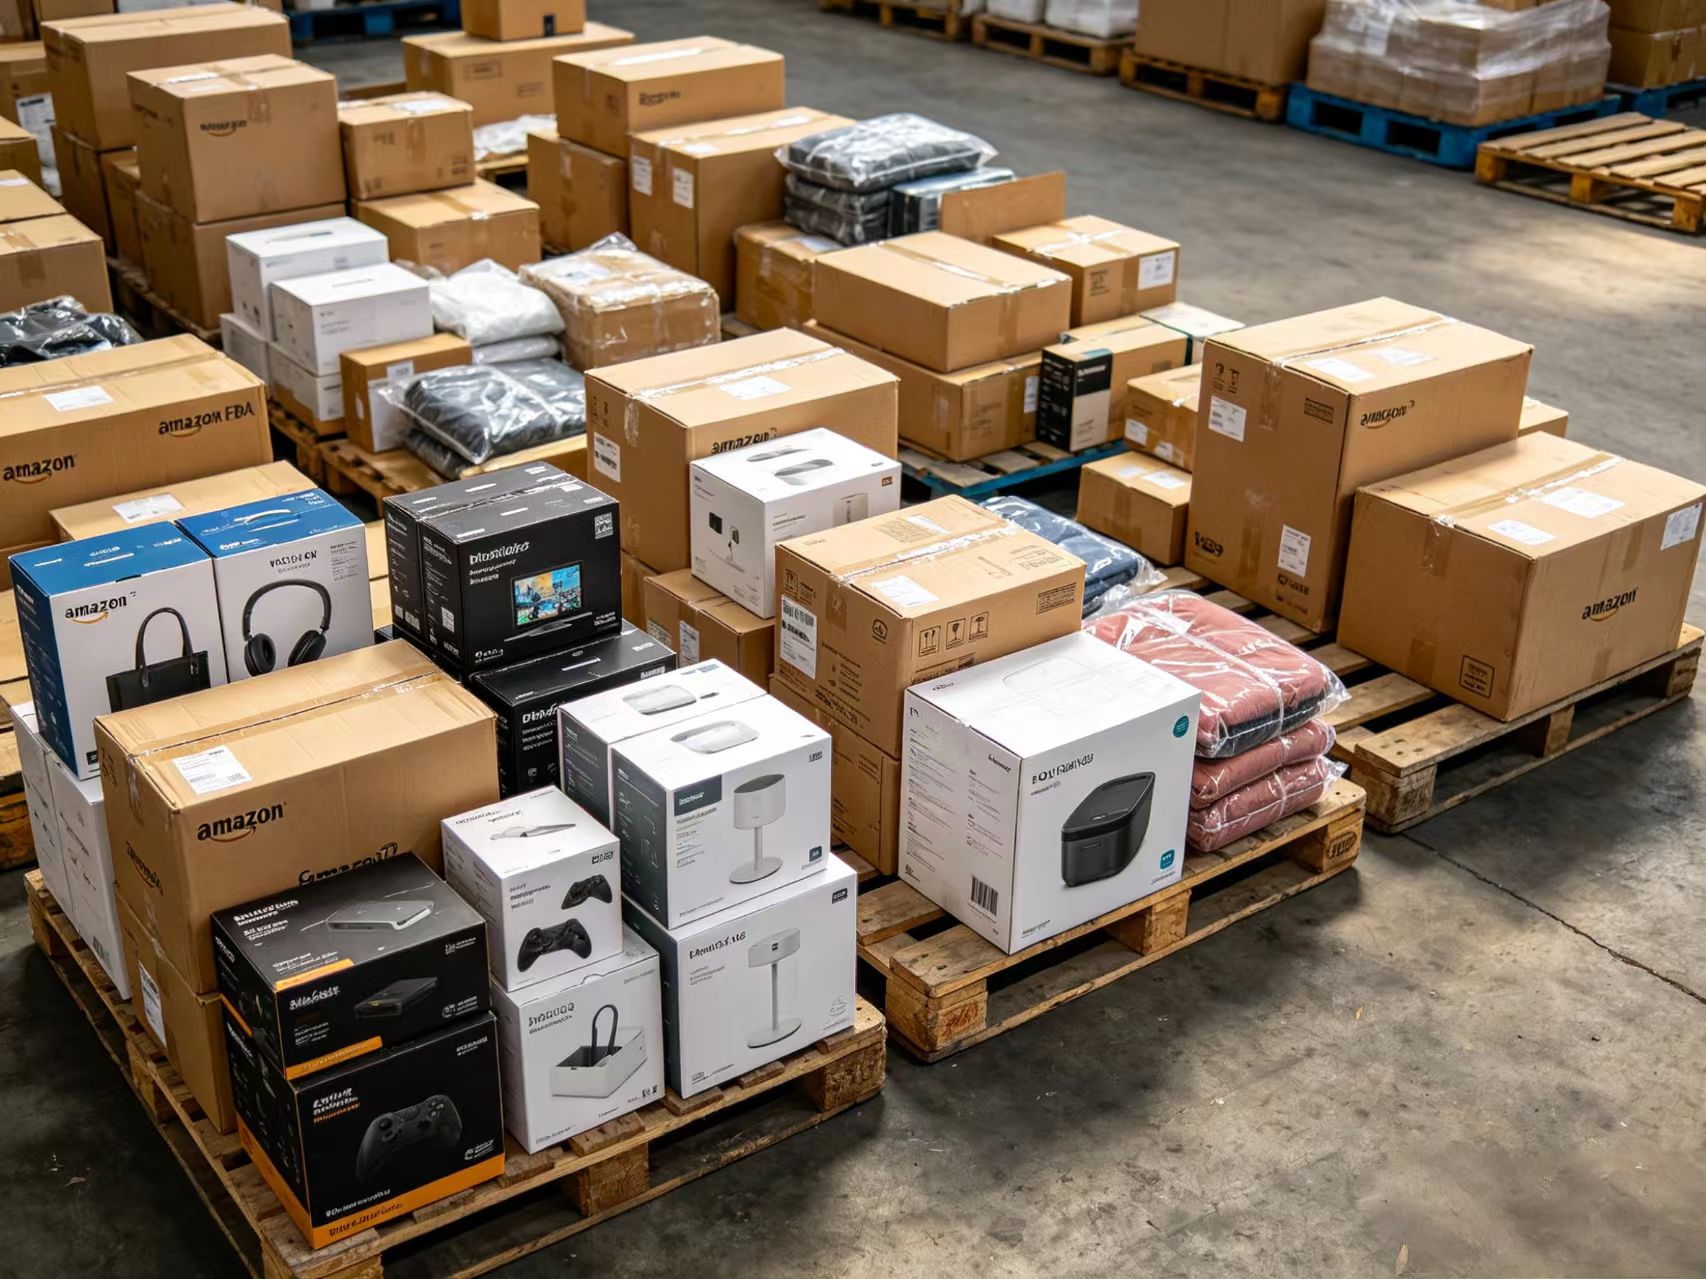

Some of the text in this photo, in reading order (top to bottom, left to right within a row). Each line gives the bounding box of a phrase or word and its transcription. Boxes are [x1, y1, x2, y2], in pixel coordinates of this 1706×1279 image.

[3, 455, 75, 481] amazon
[65, 596, 127, 619] amazon
[1582, 590, 1637, 620] amazon
[197, 804, 284, 841] amazon
